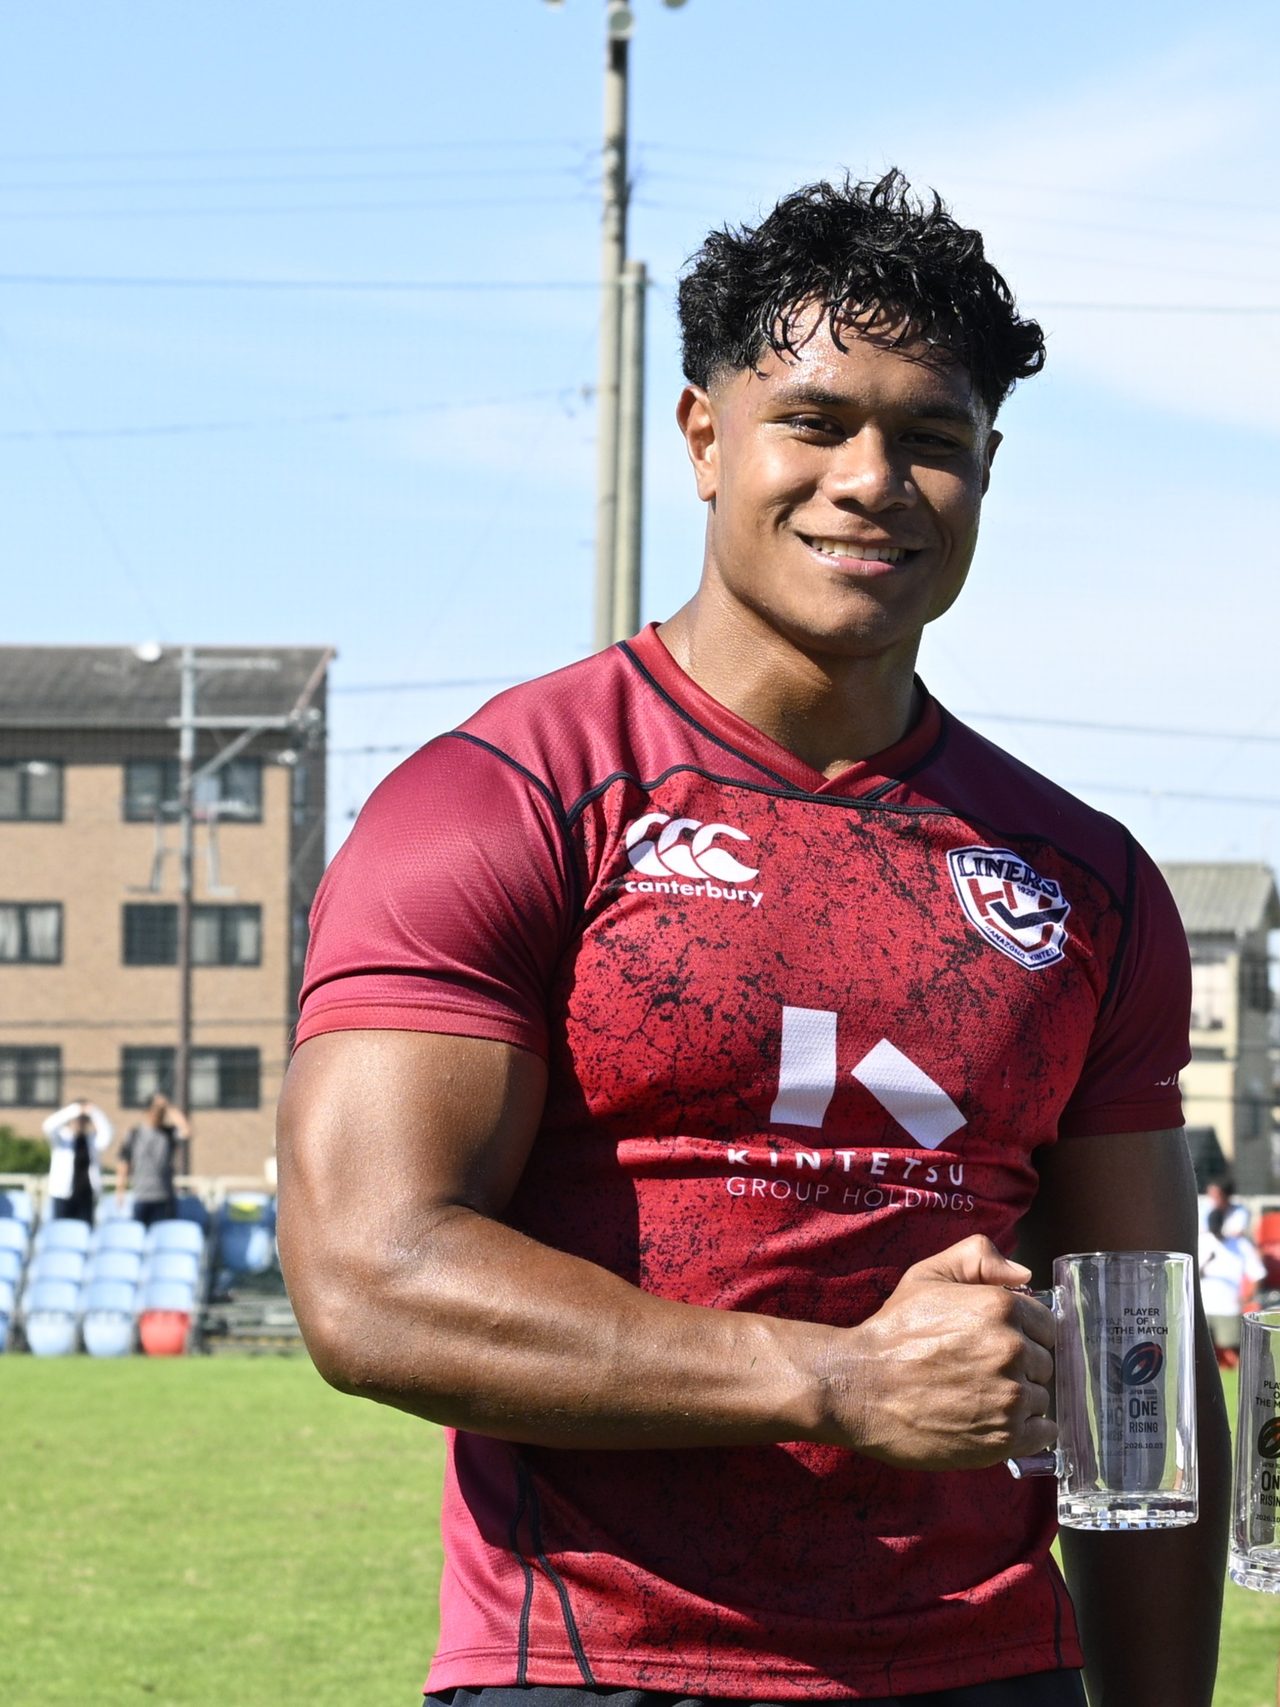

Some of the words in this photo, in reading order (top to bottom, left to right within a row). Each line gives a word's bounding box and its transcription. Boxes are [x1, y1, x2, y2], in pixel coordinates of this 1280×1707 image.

[957, 854, 1059, 898] LINERS
[624, 878, 764, 907] canterbury
[727, 1147, 965, 1187] KINTETSU
[726, 1176, 830, 1203] GROUP
[843, 1187, 976, 1213] HOLDINGS
[1124, 1308, 1160, 1317] PLAYER
[1136, 1317, 1149, 1325] OF
[1114, 1326, 1135, 1335] THE
[1137, 1327, 1169, 1335] MATCH
[1128, 1397, 1158, 1419] ONE
[1256, 1397, 1272, 1407] THE
[1129, 1421, 1159, 1433] RISING
